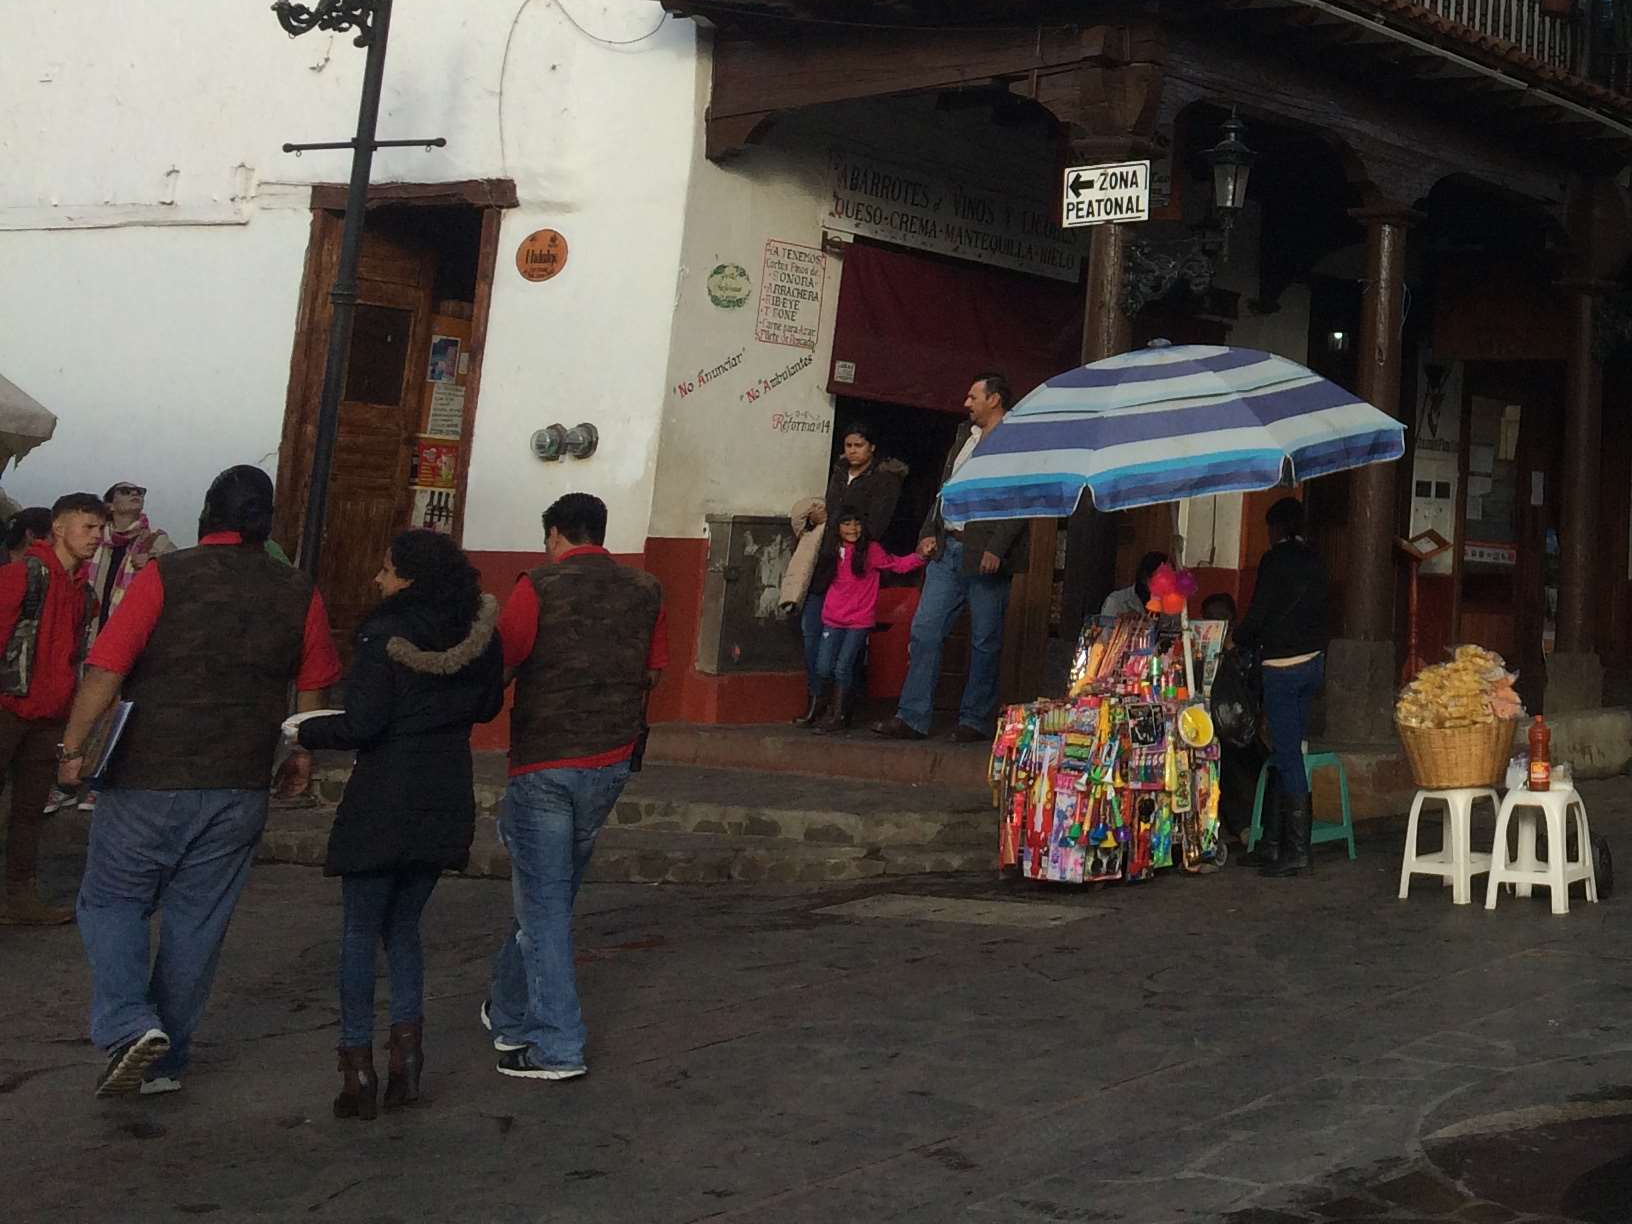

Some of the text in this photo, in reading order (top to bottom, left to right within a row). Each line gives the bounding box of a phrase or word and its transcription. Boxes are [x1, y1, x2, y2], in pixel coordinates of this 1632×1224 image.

[835, 162, 930, 210] ABARROTES
[1098, 170, 1139, 192] ZONA
[1066, 195, 1146, 221] PEATONAL
